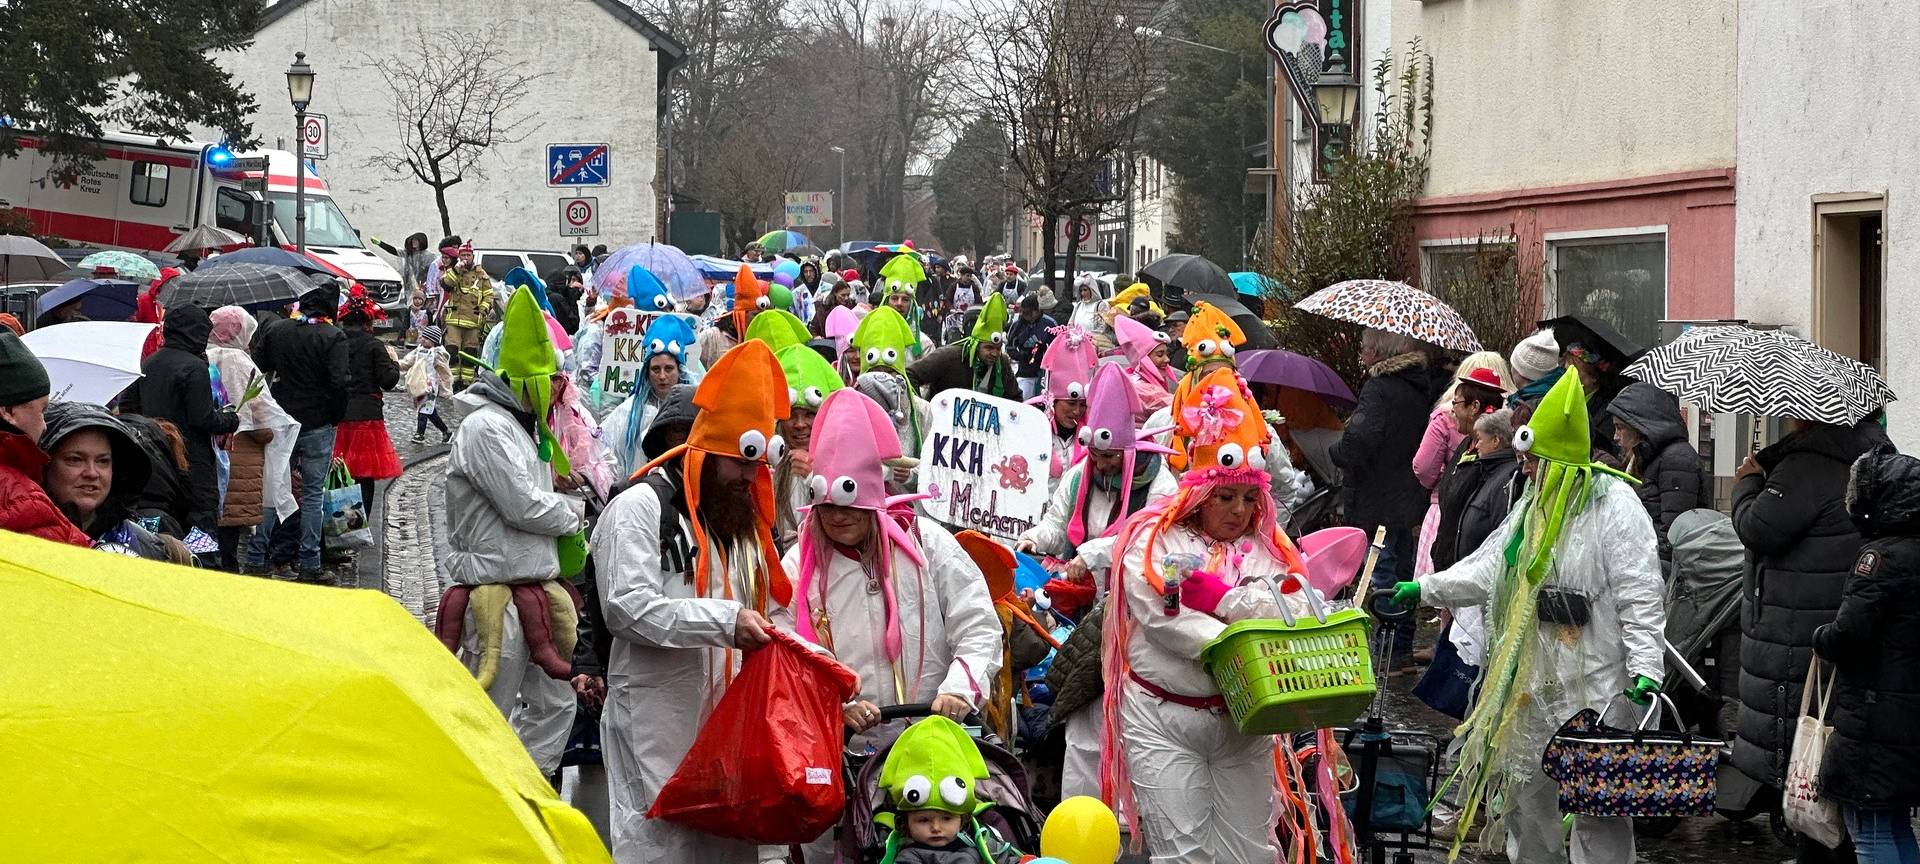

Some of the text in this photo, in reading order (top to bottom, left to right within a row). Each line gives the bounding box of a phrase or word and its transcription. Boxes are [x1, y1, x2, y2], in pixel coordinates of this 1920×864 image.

[308, 126, 318, 138] 30
[306, 145, 320, 153] ZONE
[81, 176, 101, 185] Rotes
[80, 184, 101, 193] Kreuz
[571, 207, 586, 219] 30
[569, 226, 589, 234] ZONE
[932, 432, 985, 477] KKH
